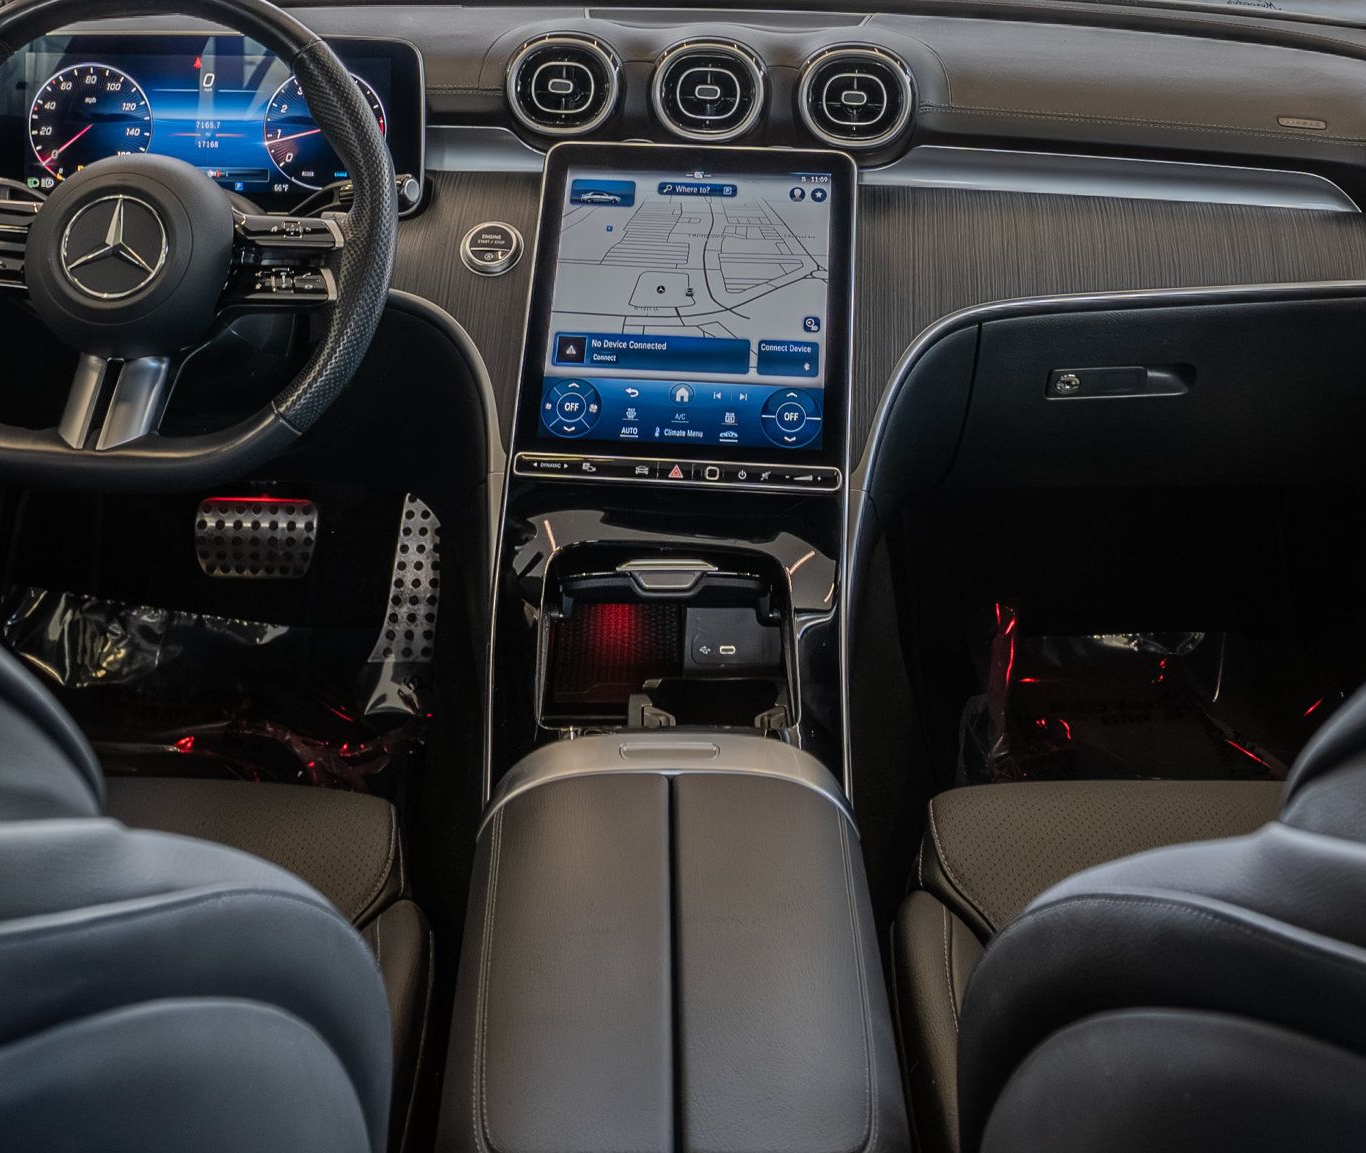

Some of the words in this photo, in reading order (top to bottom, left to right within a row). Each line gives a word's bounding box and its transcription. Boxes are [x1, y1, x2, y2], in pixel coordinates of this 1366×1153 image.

[85, 75, 97, 84] 80
[202, 73, 215, 87] 0
[106, 83, 121, 91] 100
[84, 96, 97, 104] mph
[44, 101, 56, 110] 40
[122, 102, 136, 111] 120
[280, 104, 288, 113] 2
[39, 127, 52, 136] 20
[126, 128, 140, 136] 140
[286, 153, 293, 162] 0
[675, 185, 698, 193] Where
[699, 186, 710, 194] to?
[591, 339, 601, 348] No
[603, 339, 627, 349] Device
[628, 341, 667, 351] Connected
[760, 343, 788, 353] Connect
[789, 344, 812, 353] Device
[592, 353, 617, 362] Connect
[564, 402, 579, 412] OFF
[674, 413, 686, 421] A/C
[783, 412, 799, 422] OFF
[621, 427, 638, 435] AUTO
[663, 428, 686, 437] Climate
[686, 429, 704, 438] Menu
